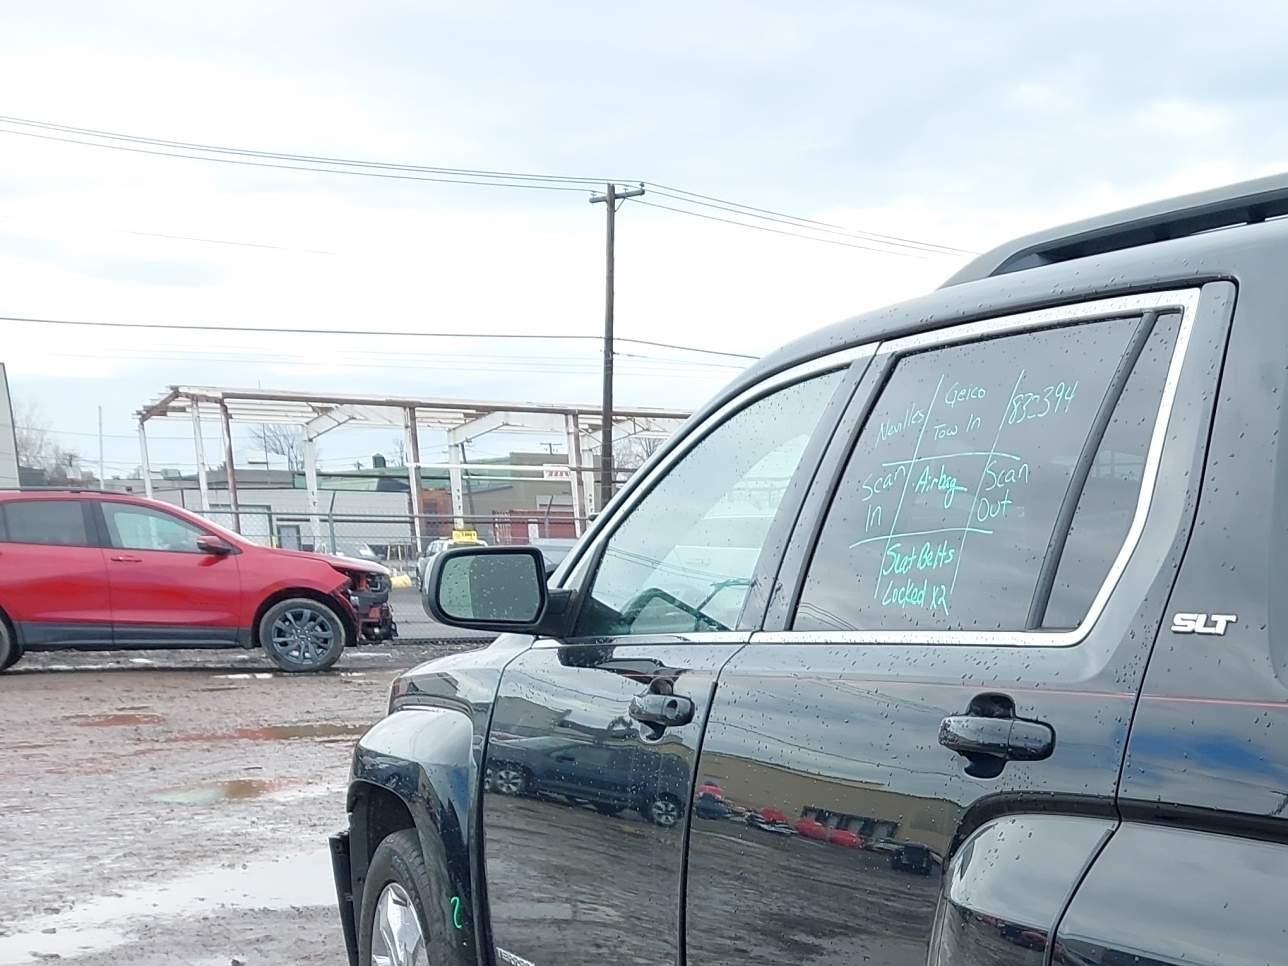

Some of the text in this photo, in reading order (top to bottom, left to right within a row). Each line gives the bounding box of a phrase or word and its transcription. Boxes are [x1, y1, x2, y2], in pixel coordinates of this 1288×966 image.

[944, 380, 986, 408] Geico
[933, 423, 958, 441] Tow
[862, 465, 906, 501] Scan
[985, 460, 1028, 491] Scan
[1171, 613, 1237, 635] SLT
